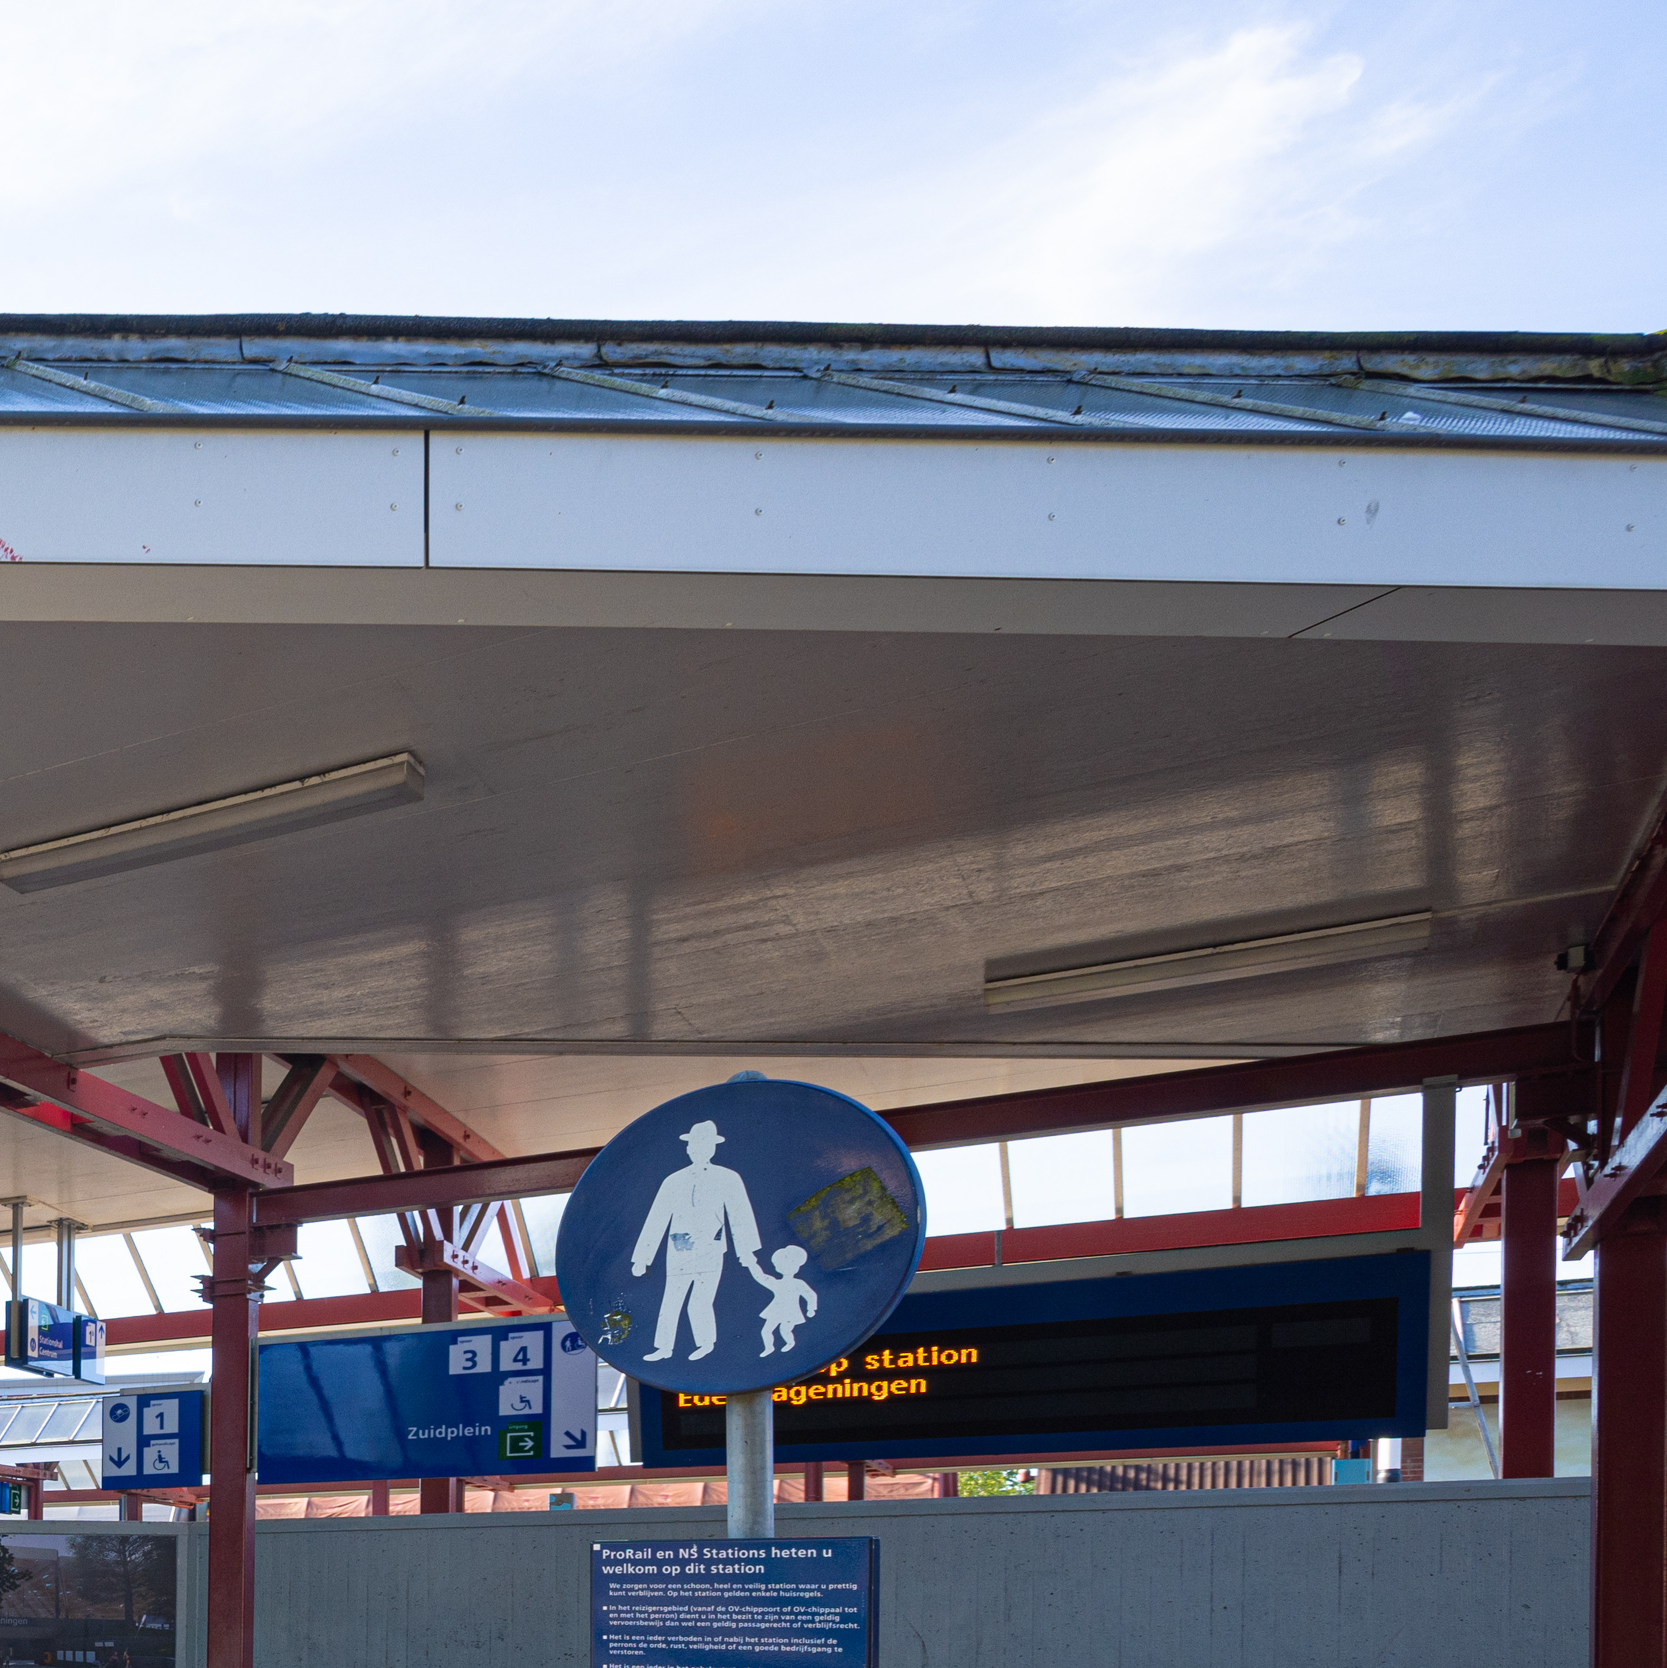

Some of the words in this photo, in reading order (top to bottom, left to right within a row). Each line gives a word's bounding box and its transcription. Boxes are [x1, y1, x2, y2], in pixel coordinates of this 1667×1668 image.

[39, 1335, 64, 1349] Stationshal
[38, 1347, 58, 1359] Centrum
[462, 1349, 478, 1371] 3
[512, 1345, 531, 1366] 4
[865, 1346, 979, 1370] station
[154, 1411, 166, 1430] 1
[407, 1422, 492, 1441] Zuidplein
[601, 1549, 651, 1560] ProRail
[655, 1551, 674, 1559] en
[678, 1549, 698, 1559] NS
[702, 1548, 766, 1559] Stations
[770, 1547, 817, 1558] heten
[822, 1549, 832, 1558] u
[601, 1564, 657, 1574] welkom
[661, 1566, 680, 1576] op
[684, 1563, 705, 1574] dit
[710, 1563, 764, 1574] station
[682, 1582, 712, 1591] schoon,
[743, 1582, 766, 1591] veilig
[827, 1582, 858, 1591] prettig
